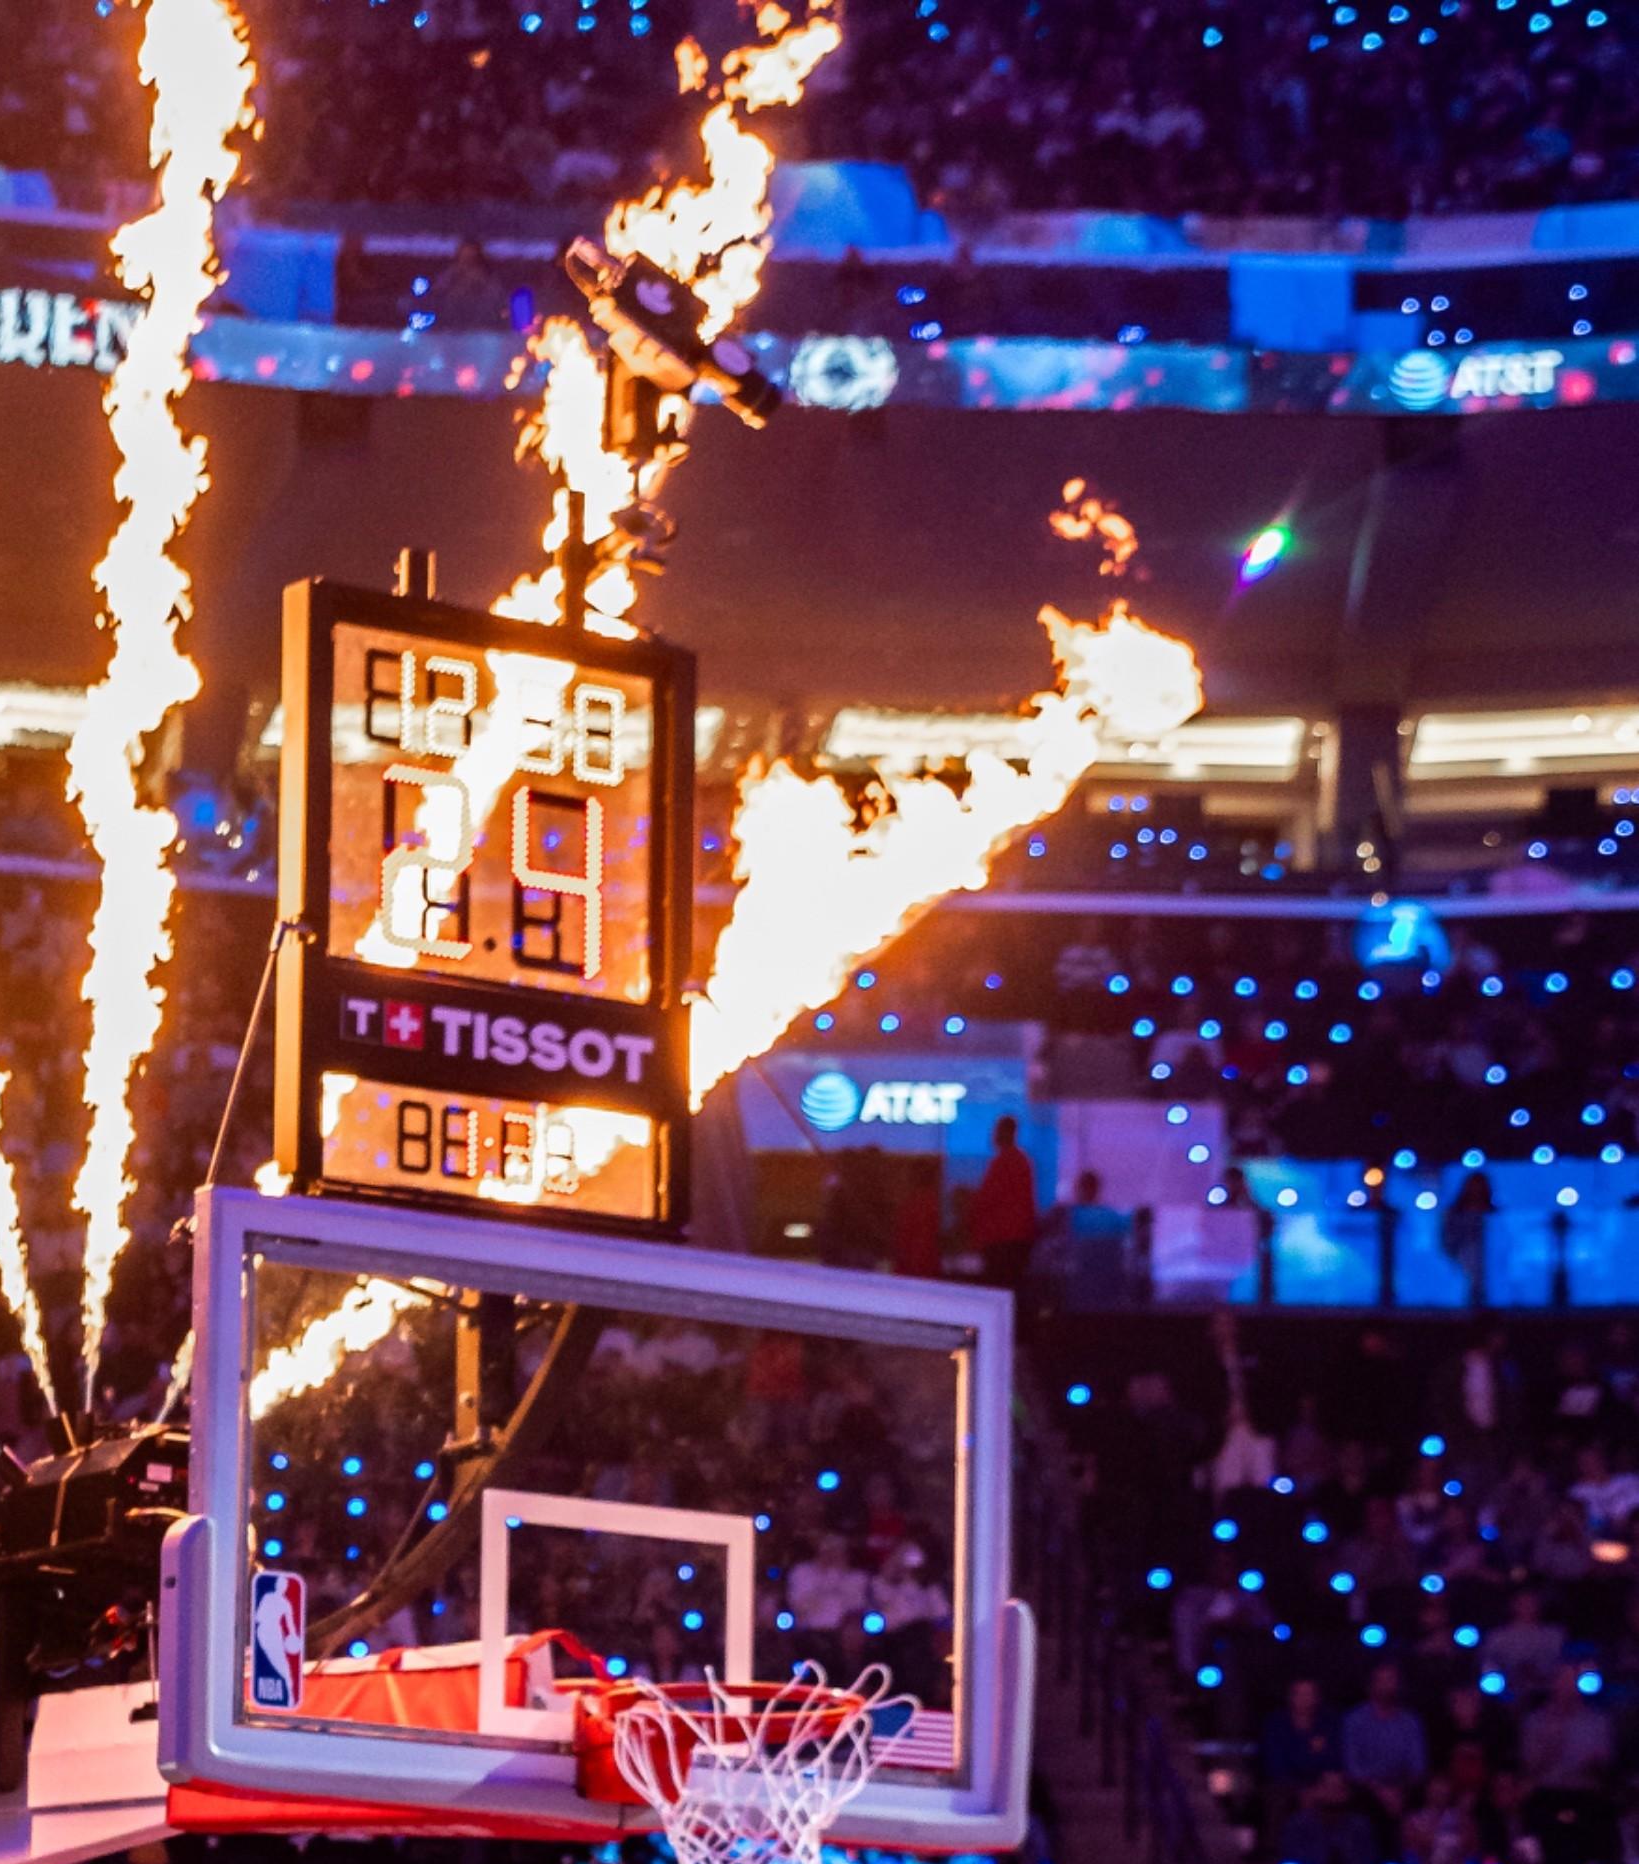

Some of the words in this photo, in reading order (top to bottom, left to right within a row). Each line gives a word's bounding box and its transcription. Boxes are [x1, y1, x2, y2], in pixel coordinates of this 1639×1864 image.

[1450, 350, 1564, 398] AT&T
[380, 763, 605, 981] 24
[430, 1005, 656, 1083] TISSOT
[860, 1083, 967, 1124] AT&T
[258, 1677, 283, 1701] NBA
